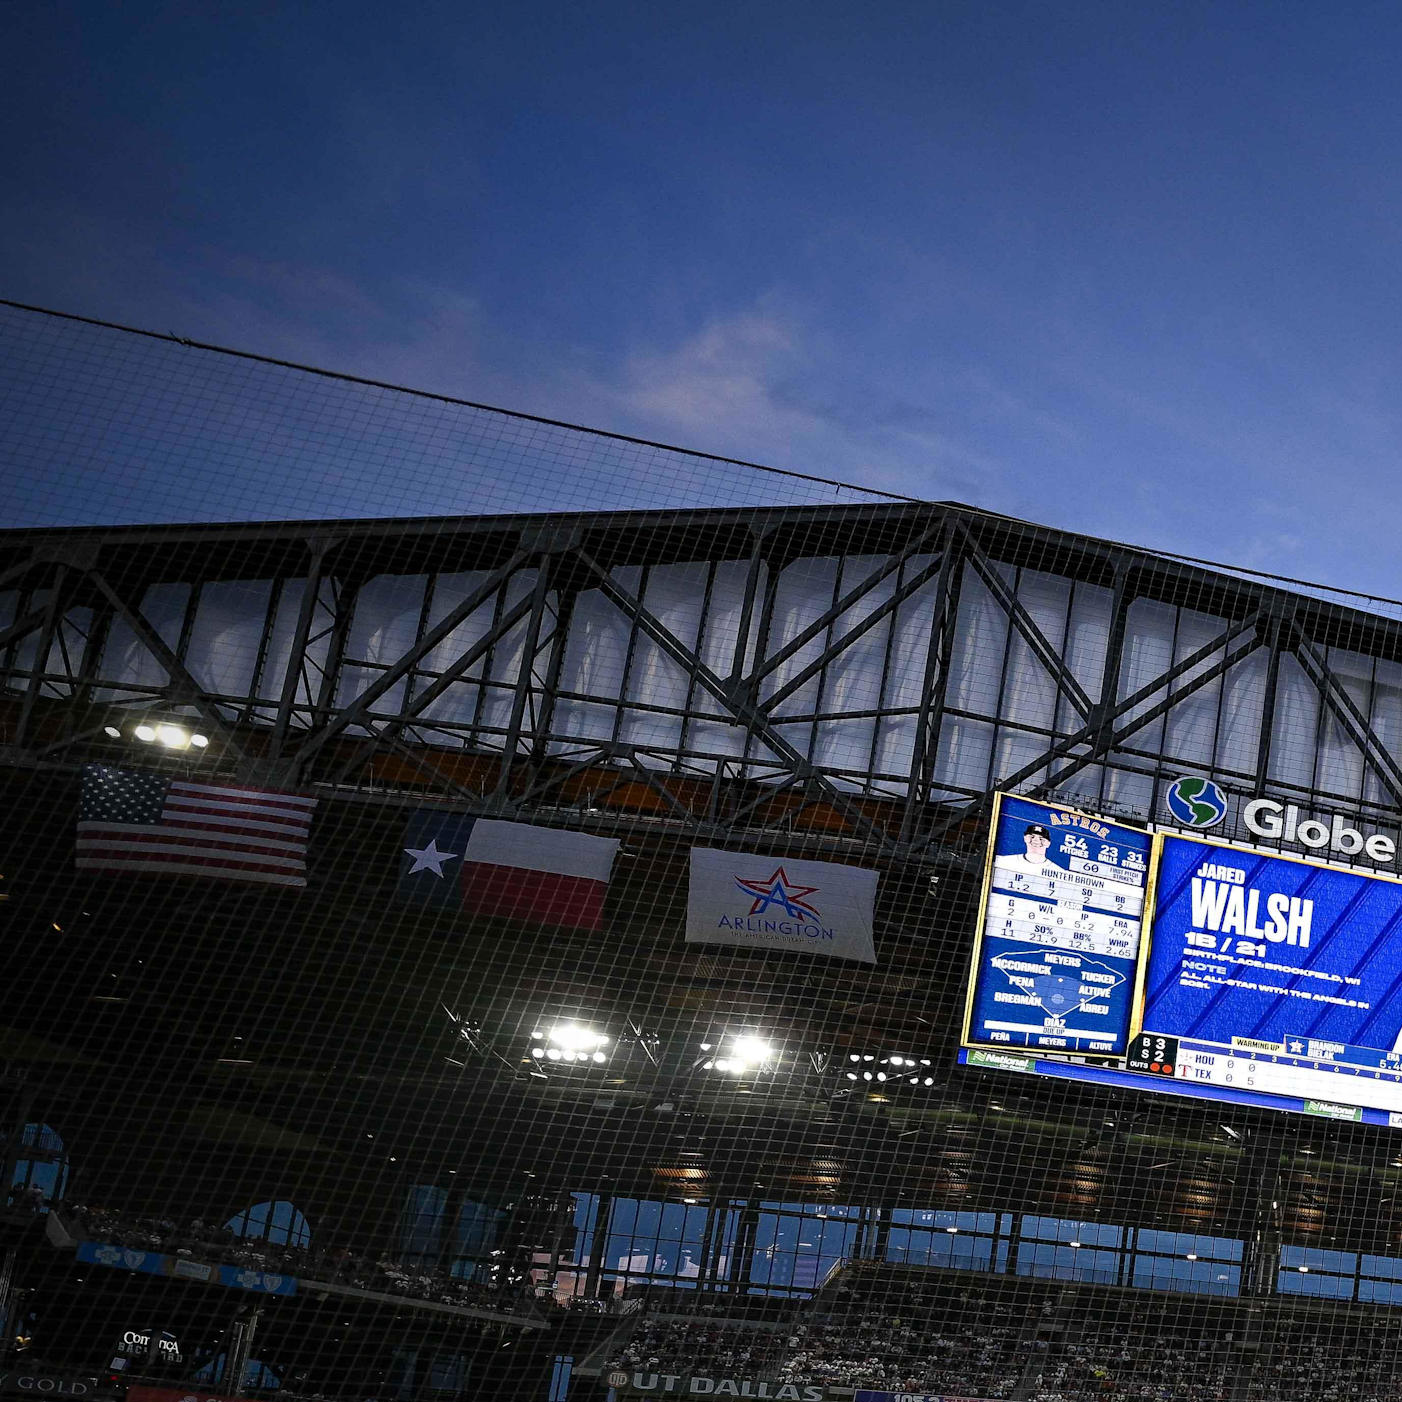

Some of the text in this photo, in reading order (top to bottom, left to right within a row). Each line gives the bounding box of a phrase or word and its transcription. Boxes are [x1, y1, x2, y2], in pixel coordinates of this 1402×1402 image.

[1050, 813, 1110, 840] ASTROS
[1243, 798, 1396, 863] Globe
[1064, 834, 1088, 849] 54
[1101, 845, 1118, 858] 23
[1127, 851, 1143, 865] 31
[1042, 869, 1104, 888] HUNTER BROWN
[1197, 862, 1246, 885] JARED
[1191, 877, 1314, 948] WALSH
[718, 914, 833, 941] ARLINGTON
[1184, 931, 1267, 958] 1B / 21
[1181, 960, 1227, 975] NOTE
[1081, 971, 1116, 985] TUCKER
[1078, 985, 1112, 999] ALTUVE
[1259, 984, 1290, 996] WITH
[994, 992, 1042, 1007] BREGMAN
[1079, 1002, 1109, 1015] ABREU
[1143, 1038, 1166, 1050] B 3
[1237, 1038, 1280, 1052] WARMING UP
[1307, 1040, 1345, 1054] BRANDON
[985, 1052, 1029, 1068] National
[1154, 1051, 1164, 1062] 2
[1195, 1054, 1215, 1066] HOU
[1130, 1060, 1149, 1070] OUTS
[1195, 1067, 1211, 1080] TEX
[1319, 1103, 1357, 1117] National
[17, 1376, 88, 1395] GOLD
[631, 1371, 824, 1402] UT DALLAS
